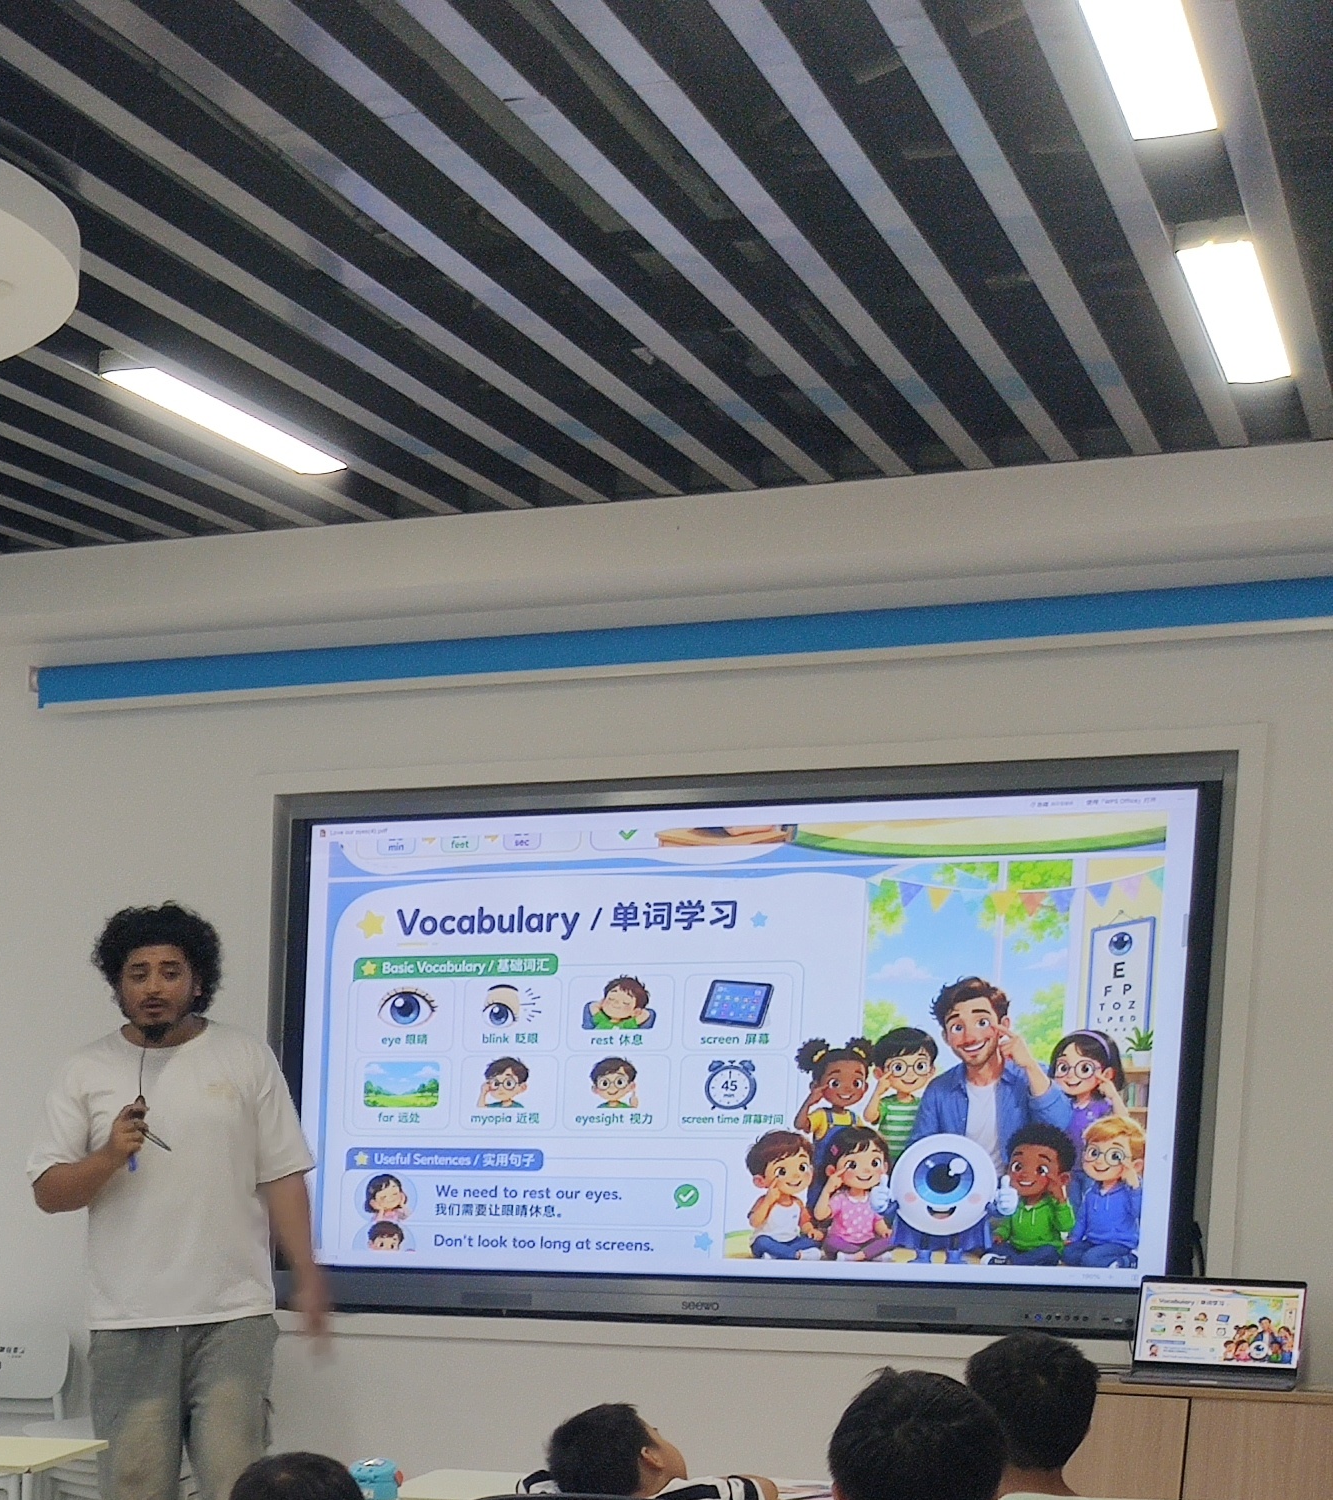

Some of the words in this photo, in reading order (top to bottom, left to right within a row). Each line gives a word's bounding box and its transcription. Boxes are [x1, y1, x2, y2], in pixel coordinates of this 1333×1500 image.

[388, 841, 404, 851] min
[451, 839, 469, 849] feet
[514, 838, 530, 847] sec
[396, 905, 581, 941] Vocabulary
[590, 907, 603, 931] /
[610, 899, 738, 931] 单词学习
[382, 962, 414, 975] Basic
[416, 959, 485, 976] Vocabulary
[497, 958, 550, 973] 基础词汇
[1113, 961, 1126, 979] E
[1104, 985, 1113, 997] F
[1122, 984, 1132, 995] P
[1099, 1003, 1105, 1011] T
[1128, 1000, 1136, 1010] Z
[381, 1036, 401, 1047] eye
[405, 1033, 428, 1045] 眼睛
[482, 1033, 509, 1044] blink
[515, 1033, 538, 1045] 眨眼
[591, 1035, 614, 1045] rest
[619, 1033, 643, 1045] 休息
[700, 1035, 739, 1045] screen
[744, 1033, 770, 1045] 屏幕
[721, 1080, 738, 1092] 45
[378, 1112, 395, 1123] far
[398, 1112, 420, 1124] 远处
[471, 1113, 511, 1126] myopia
[516, 1112, 540, 1124] 近视
[575, 1112, 624, 1126] eyesight
[630, 1112, 653, 1124] 视力
[682, 1115, 714, 1124] screen
[717, 1113, 740, 1123] time
[742, 1113, 784, 1125] 屏幕时间
[374, 1153, 411, 1166] Useful
[413, 1153, 471, 1167] Sentences
[482, 1153, 535, 1167] 实用句子
[436, 1185, 459, 1198] We
[463, 1185, 498, 1199] need
[503, 1187, 518, 1199] to
[523, 1187, 551, 1199] rest
[556, 1189, 580, 1200] our
[585, 1188, 622, 1203] eyes.
[434, 1203, 563, 1219] 我们需要让眼睛休息。
[434, 1234, 473, 1248] Don't
[477, 1235, 508, 1249] look
[513, 1237, 536, 1250] too
[540, 1236, 570, 1253] long
[575, 1239, 592, 1251] at
[595, 1239, 655, 1252] screens.
[681, 1300, 720, 1311] seewo
